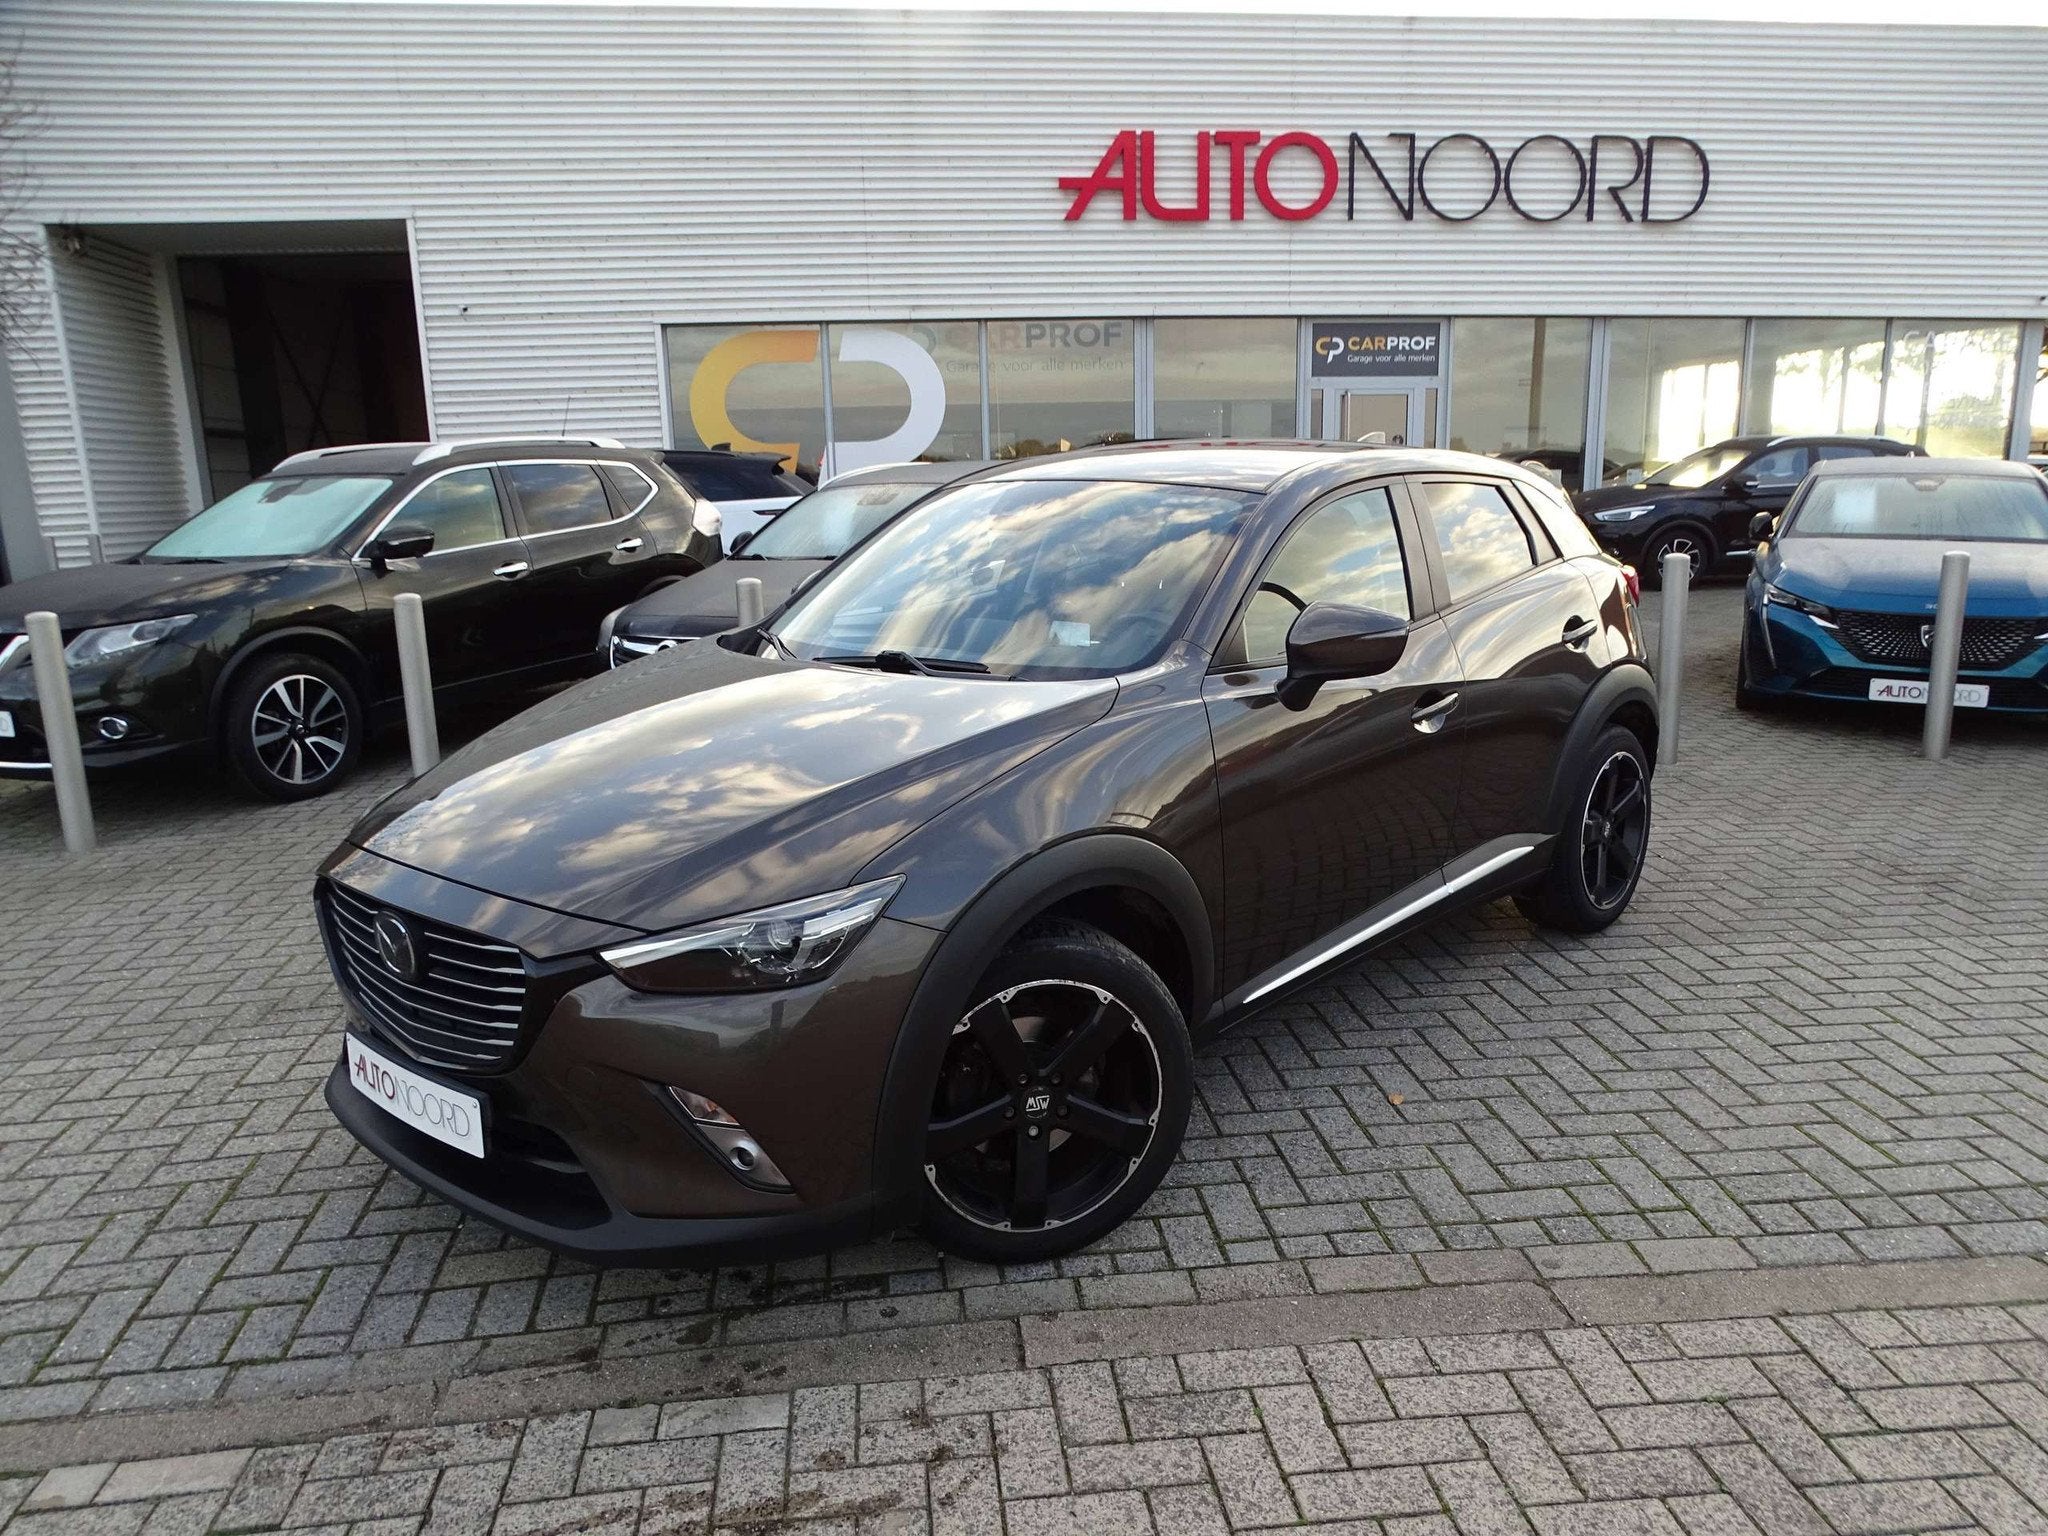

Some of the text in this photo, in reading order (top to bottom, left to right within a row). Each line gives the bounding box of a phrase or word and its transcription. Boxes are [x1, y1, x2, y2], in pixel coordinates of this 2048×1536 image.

[1348, 336, 1436, 350] CARPROF
[1348, 354, 1373, 364] Garage
[1394, 354, 1406, 362] alle
[1408, 354, 1435, 362] merken
[946, 360, 996, 374] Garae
